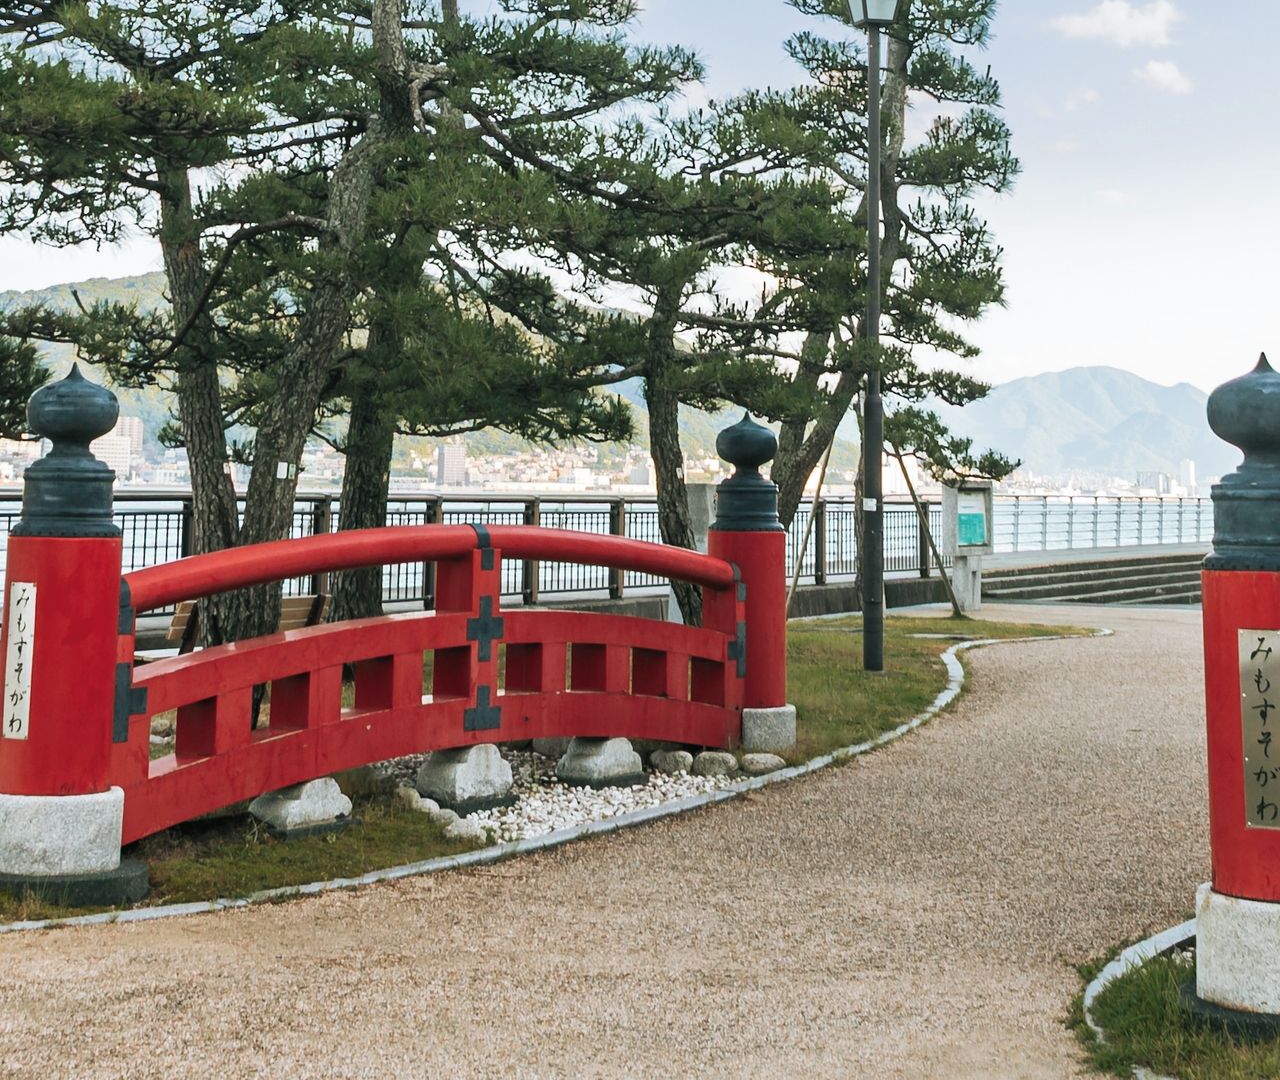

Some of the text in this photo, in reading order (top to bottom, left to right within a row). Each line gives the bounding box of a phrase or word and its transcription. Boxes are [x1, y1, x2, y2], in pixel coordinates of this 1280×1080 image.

[8, 588, 30, 733] みもすそがわ
